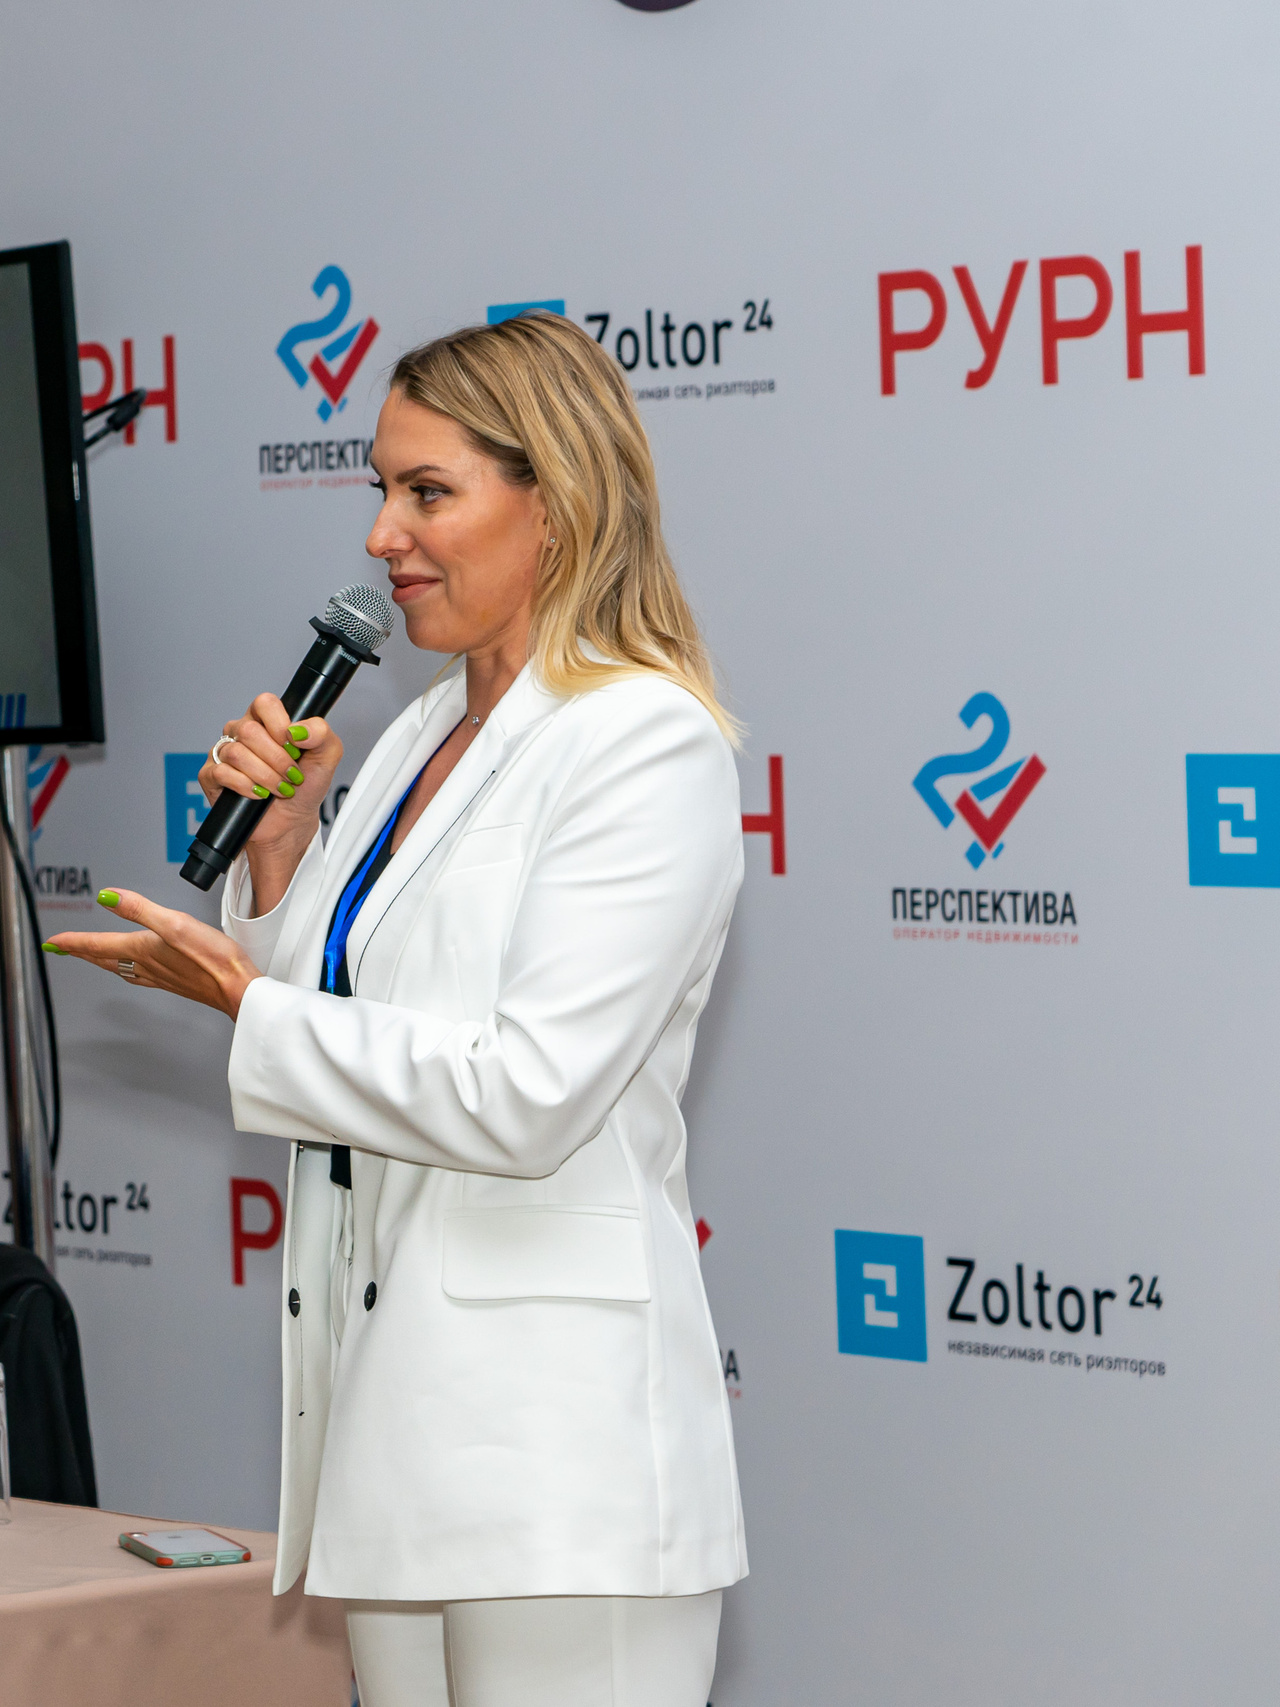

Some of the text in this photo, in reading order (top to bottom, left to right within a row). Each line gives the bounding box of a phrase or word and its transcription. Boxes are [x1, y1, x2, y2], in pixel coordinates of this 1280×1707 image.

[743, 299, 773, 332] 24
[878, 245, 1206, 397] РУРН
[674, 383, 702, 399] сеть
[706, 379, 776, 401] риэлторов
[892, 887, 1077, 925] ПЕРСПЕКТИВА
[126, 1182, 150, 1211] 24
[947, 1257, 1163, 1336] Zoltor 24
[948, 1340, 1166, 1378] независимая сеть риэлторов
